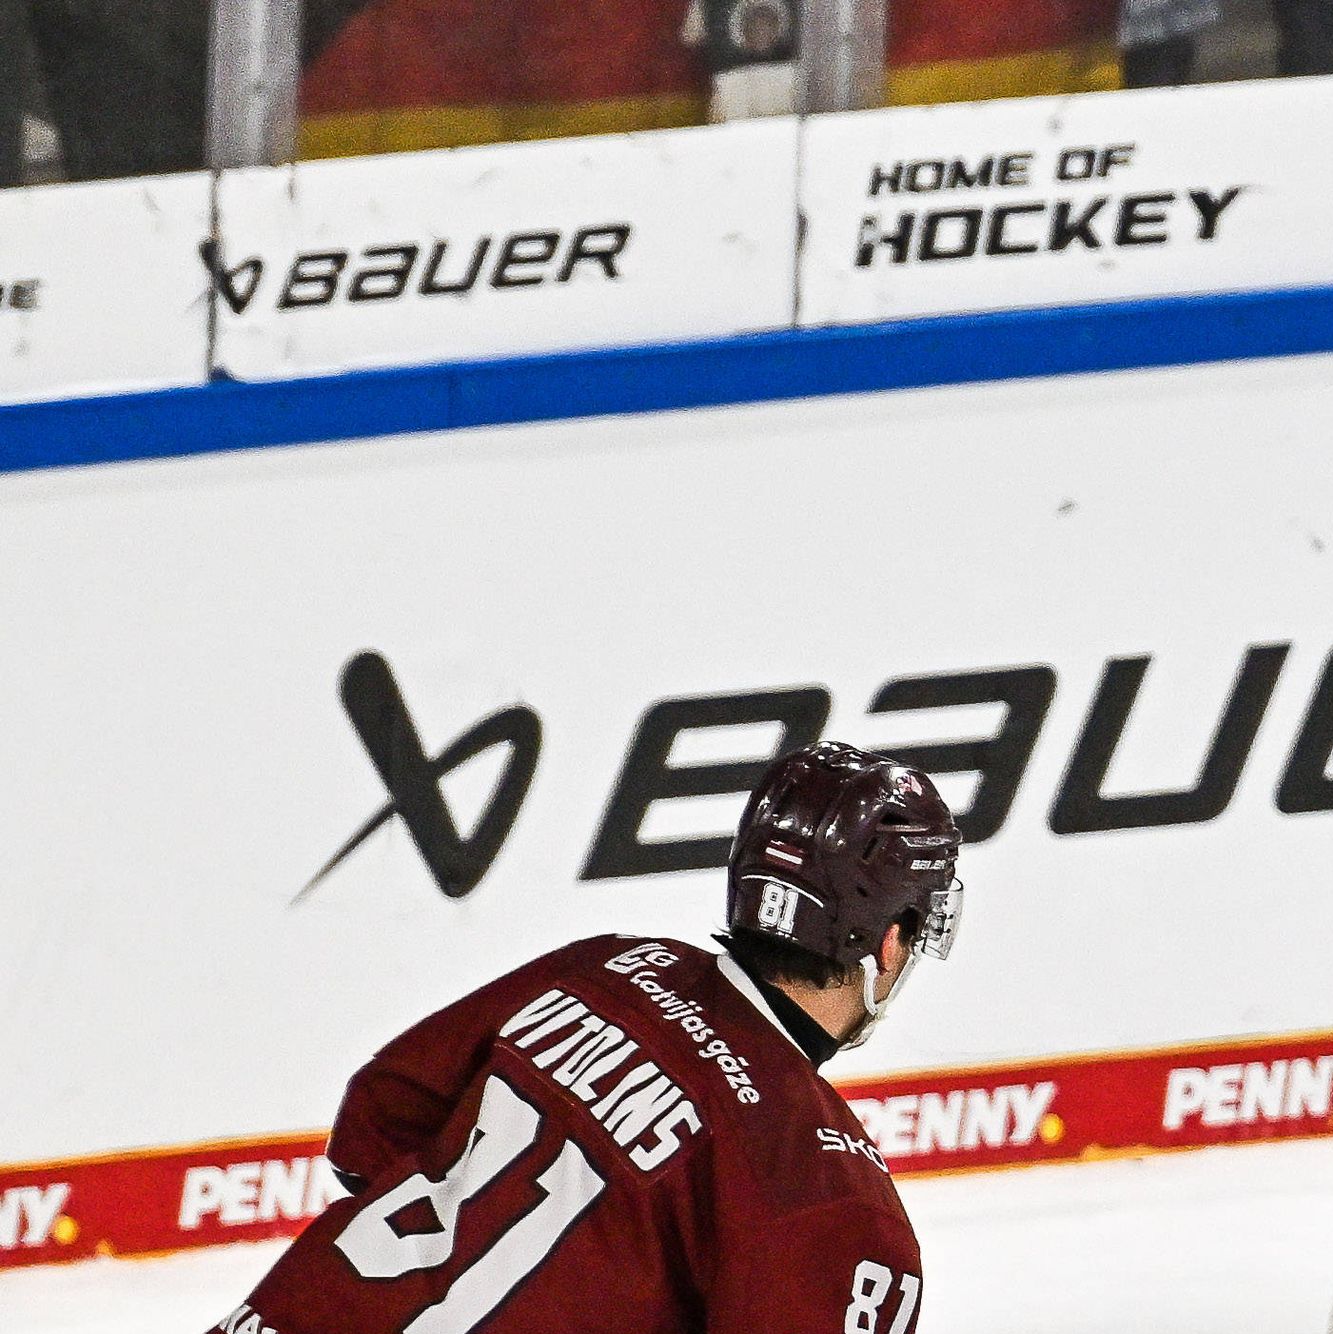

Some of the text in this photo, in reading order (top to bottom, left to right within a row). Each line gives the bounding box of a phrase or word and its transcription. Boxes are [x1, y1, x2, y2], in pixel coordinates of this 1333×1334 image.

[868, 143, 1137, 198] HOME OF
[855, 185, 1248, 268] HOCKEY
[277, 222, 632, 311] BAUER
[758, 882, 799, 934] 81
[498, 986, 704, 1176] VITOLINS
[178, 1155, 338, 1231] PENN
